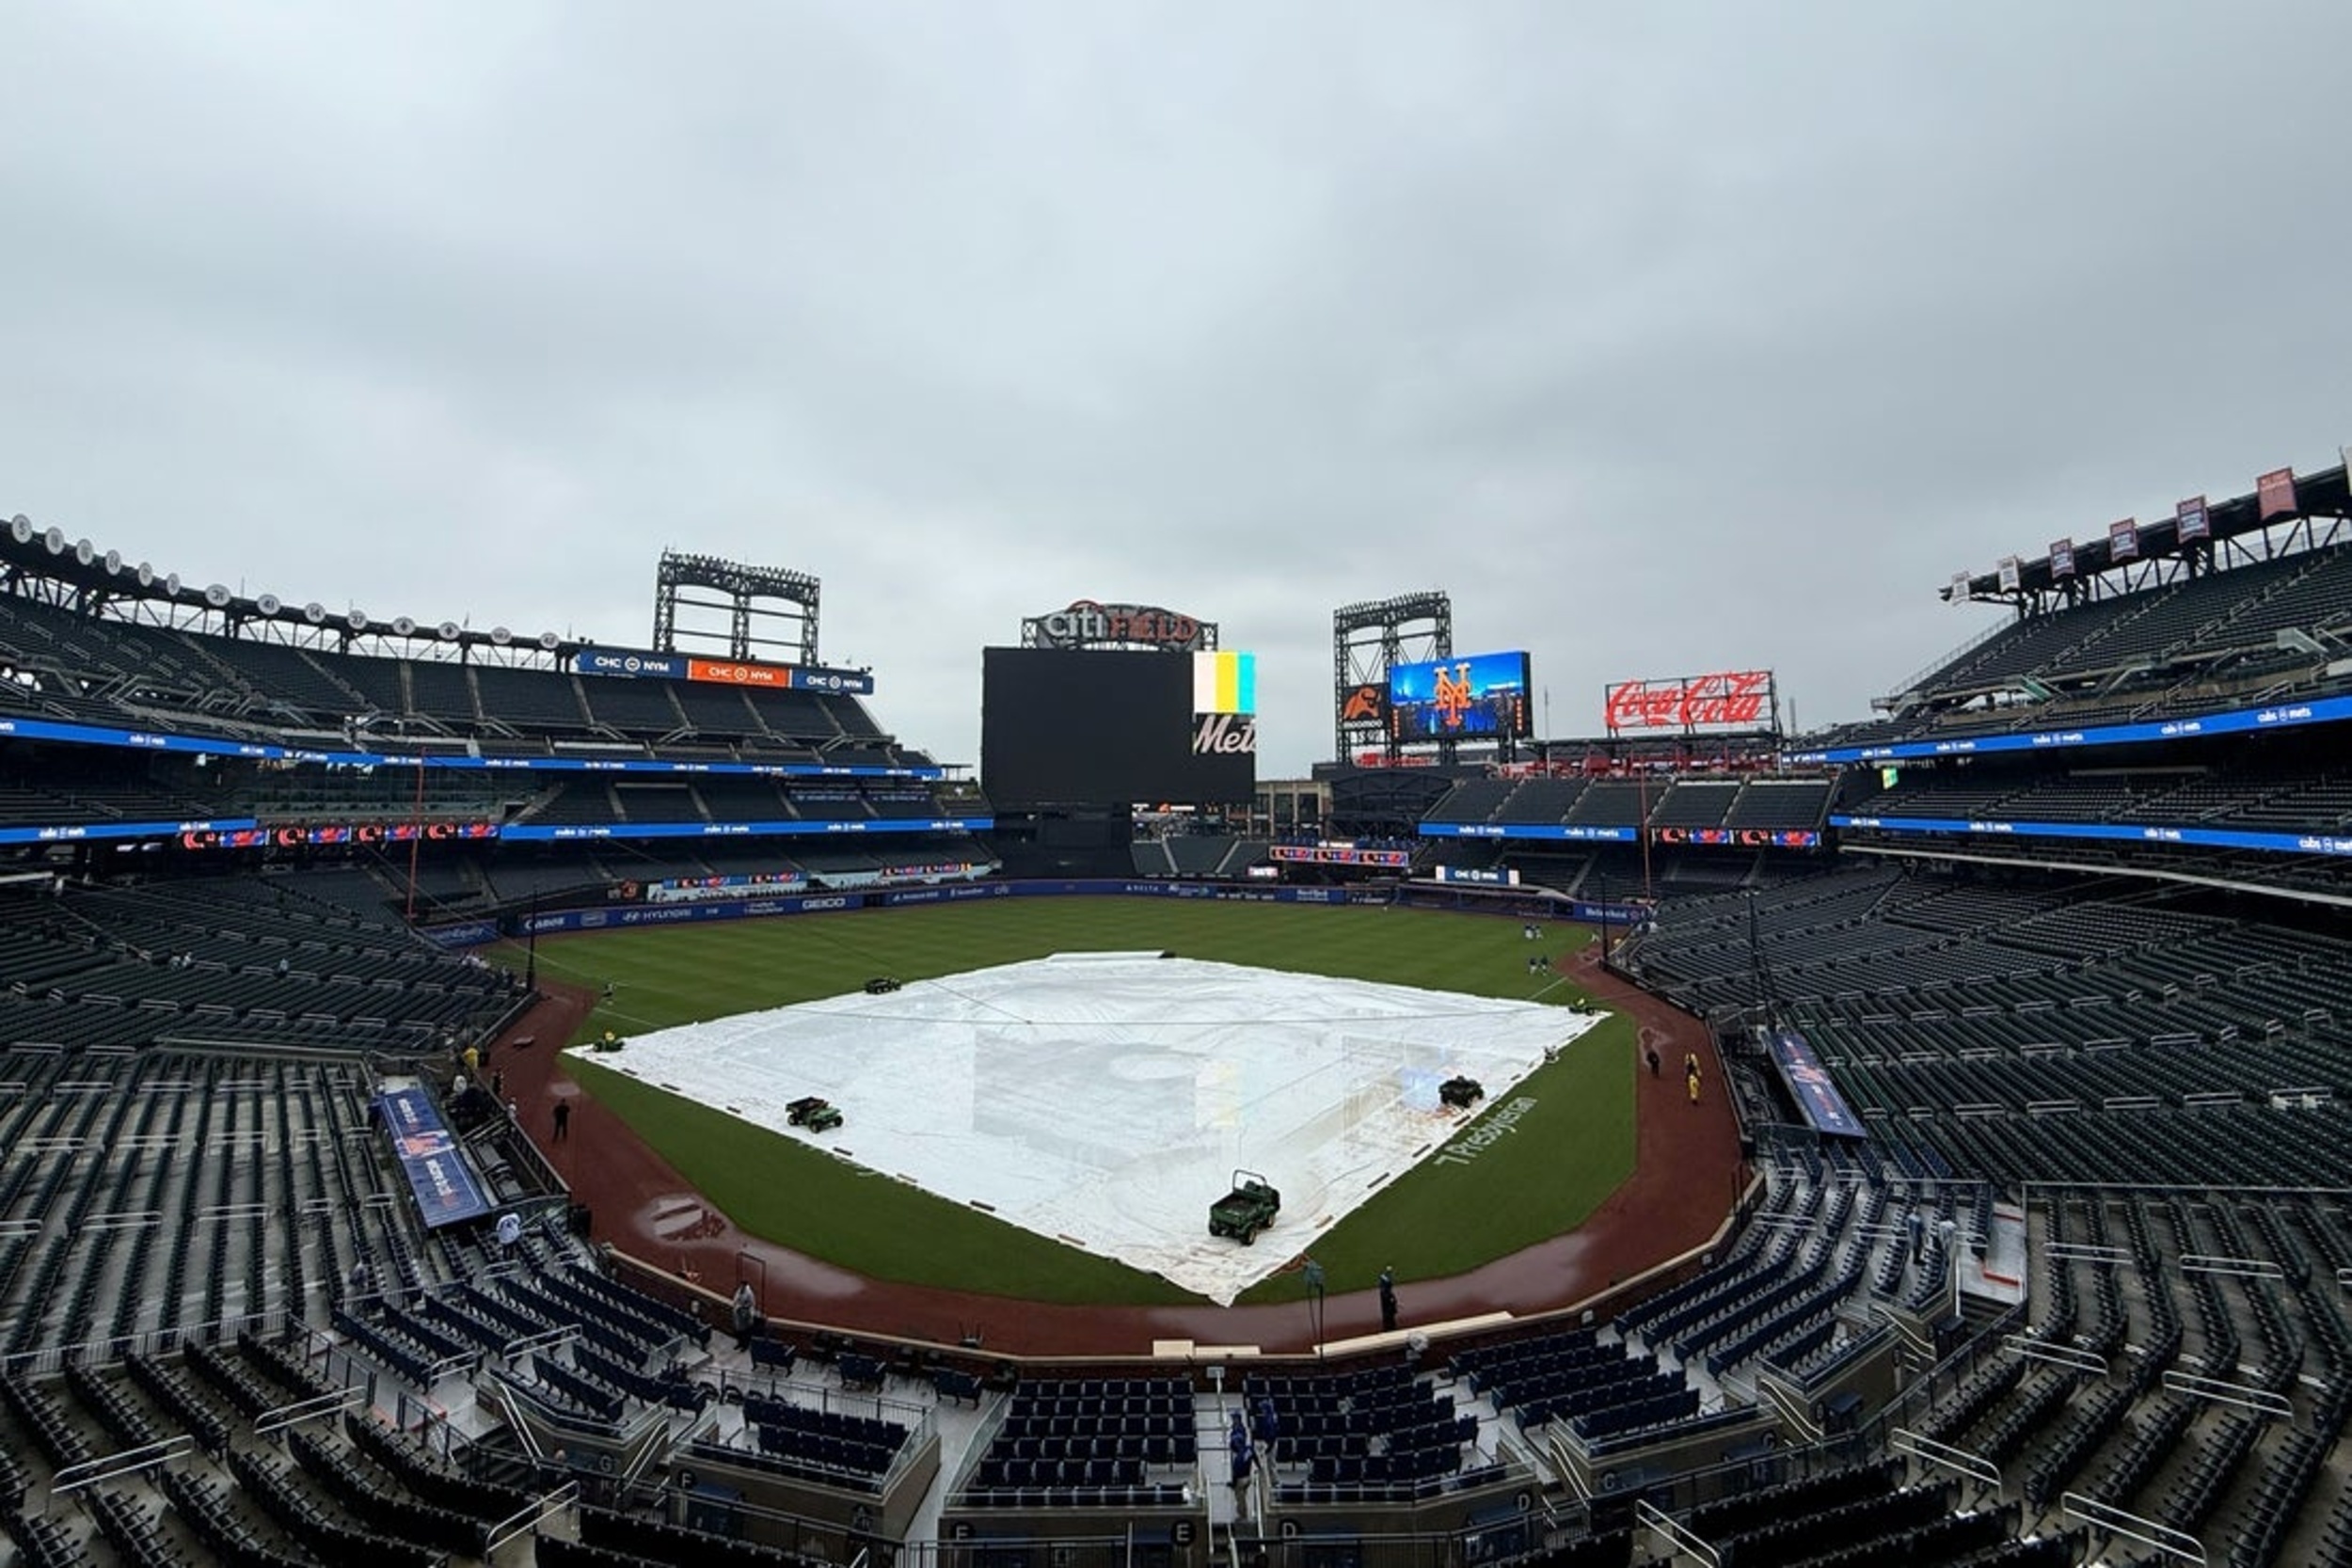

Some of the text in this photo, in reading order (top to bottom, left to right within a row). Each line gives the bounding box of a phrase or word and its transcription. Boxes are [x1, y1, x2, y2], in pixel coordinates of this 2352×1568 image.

[1044, 606, 1199, 641] citi FIELD
[595, 656, 670, 673] CHC NYM
[708, 666, 773, 681] CHC NYM
[806, 675, 827, 687] CHC
[803, 896, 846, 911] GEICO
[643, 908, 692, 921] HYUNDAI
[681, 1472, 692, 1488] F
[1518, 1494, 1531, 1511] D
[1176, 1523, 1191, 1542] E
[1282, 1522, 1296, 1539] D
